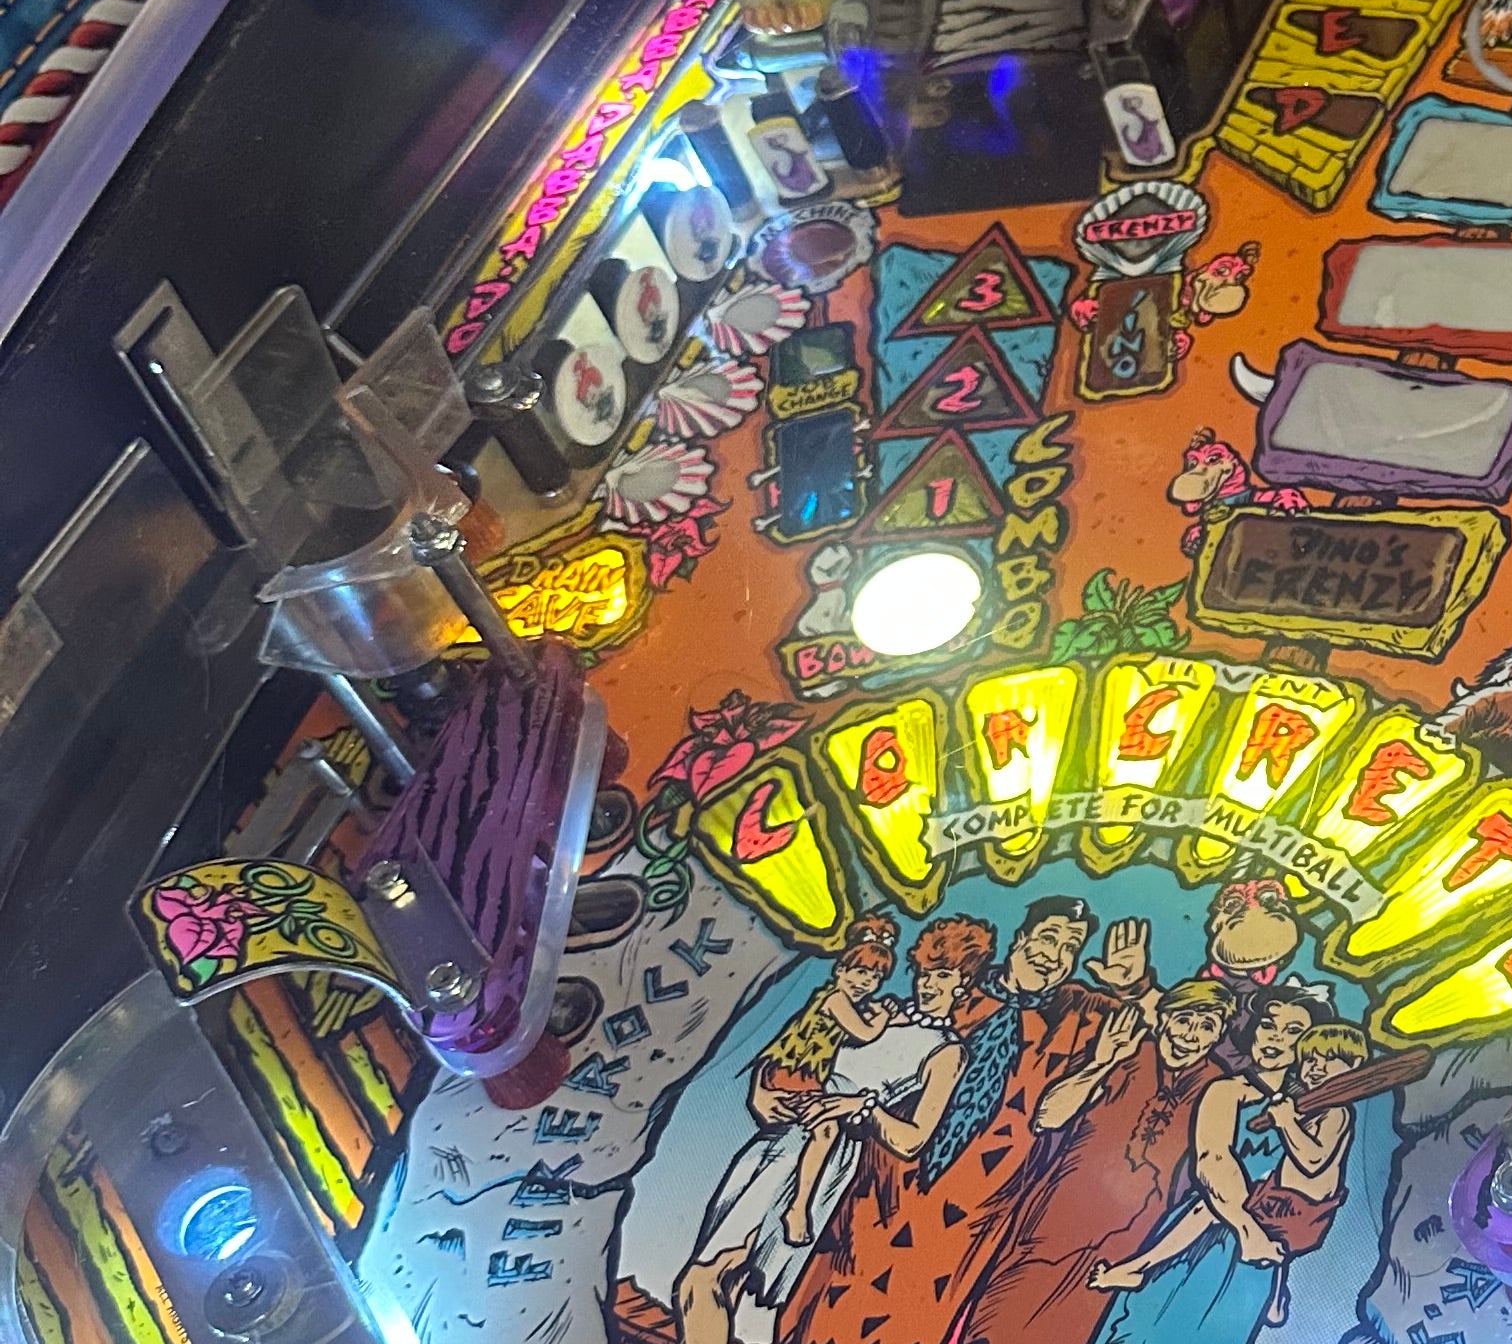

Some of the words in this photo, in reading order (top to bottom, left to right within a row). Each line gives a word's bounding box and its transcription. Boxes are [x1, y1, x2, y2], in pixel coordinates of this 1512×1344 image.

[1085, 211, 1196, 244] FRENZY
[973, 271, 1004, 313] 3
[778, 387, 851, 413] CHANGE
[931, 367, 986, 414] 2
[925, 477, 959, 518] 1
[511, 553, 626, 595] DRAIN
[1238, 560, 1425, 610] FRENZY
[1120, 793, 1182, 821] FOR
[1203, 801, 1362, 904] MULTIBALL
